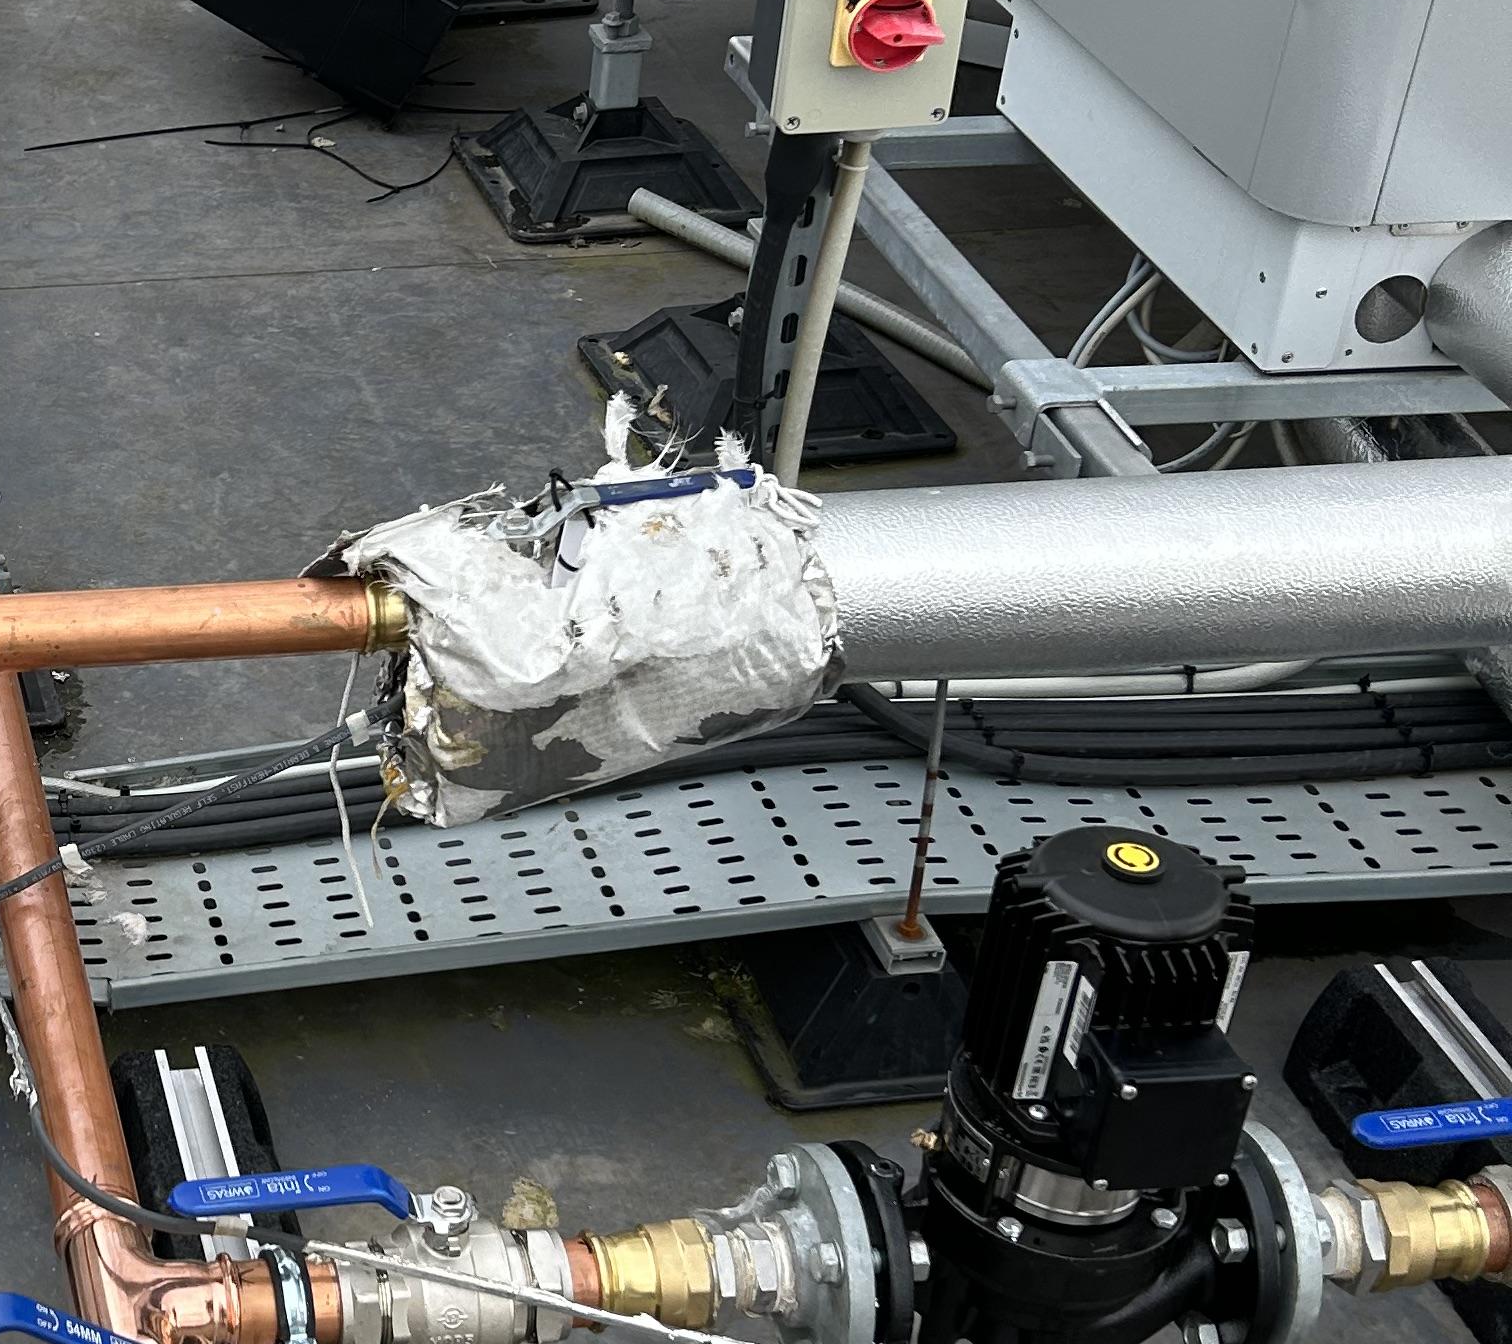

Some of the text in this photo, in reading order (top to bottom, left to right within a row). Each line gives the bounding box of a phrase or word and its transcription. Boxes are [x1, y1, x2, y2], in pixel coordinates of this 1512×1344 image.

[1389, 1117, 1424, 1129] WRAS
[1445, 1112, 1481, 1125] inta
[267, 1177, 302, 1195] inta
[207, 1186, 245, 1200] WRAS
